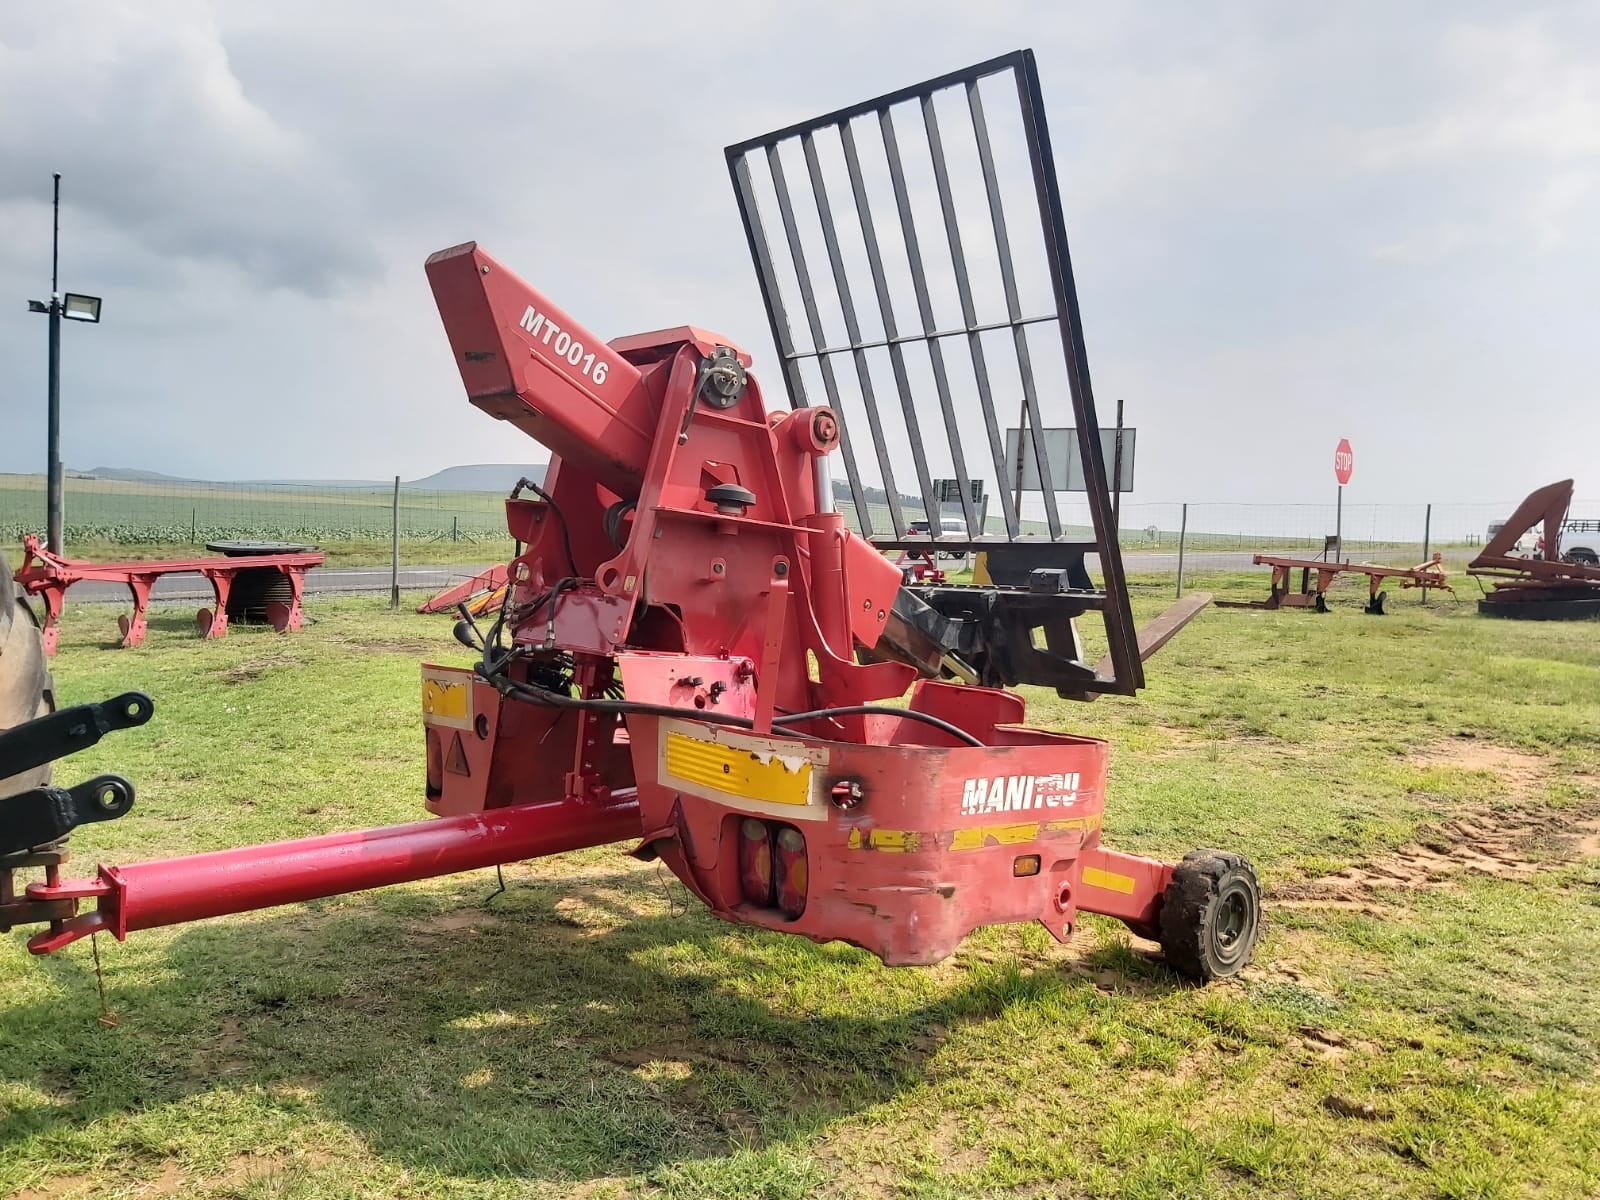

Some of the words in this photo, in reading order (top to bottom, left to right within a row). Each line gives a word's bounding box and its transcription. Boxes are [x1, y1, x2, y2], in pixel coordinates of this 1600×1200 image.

[520, 305, 608, 385] MT0016
[1336, 451, 1352, 471] STOP
[961, 772, 1080, 815] MANITOU
